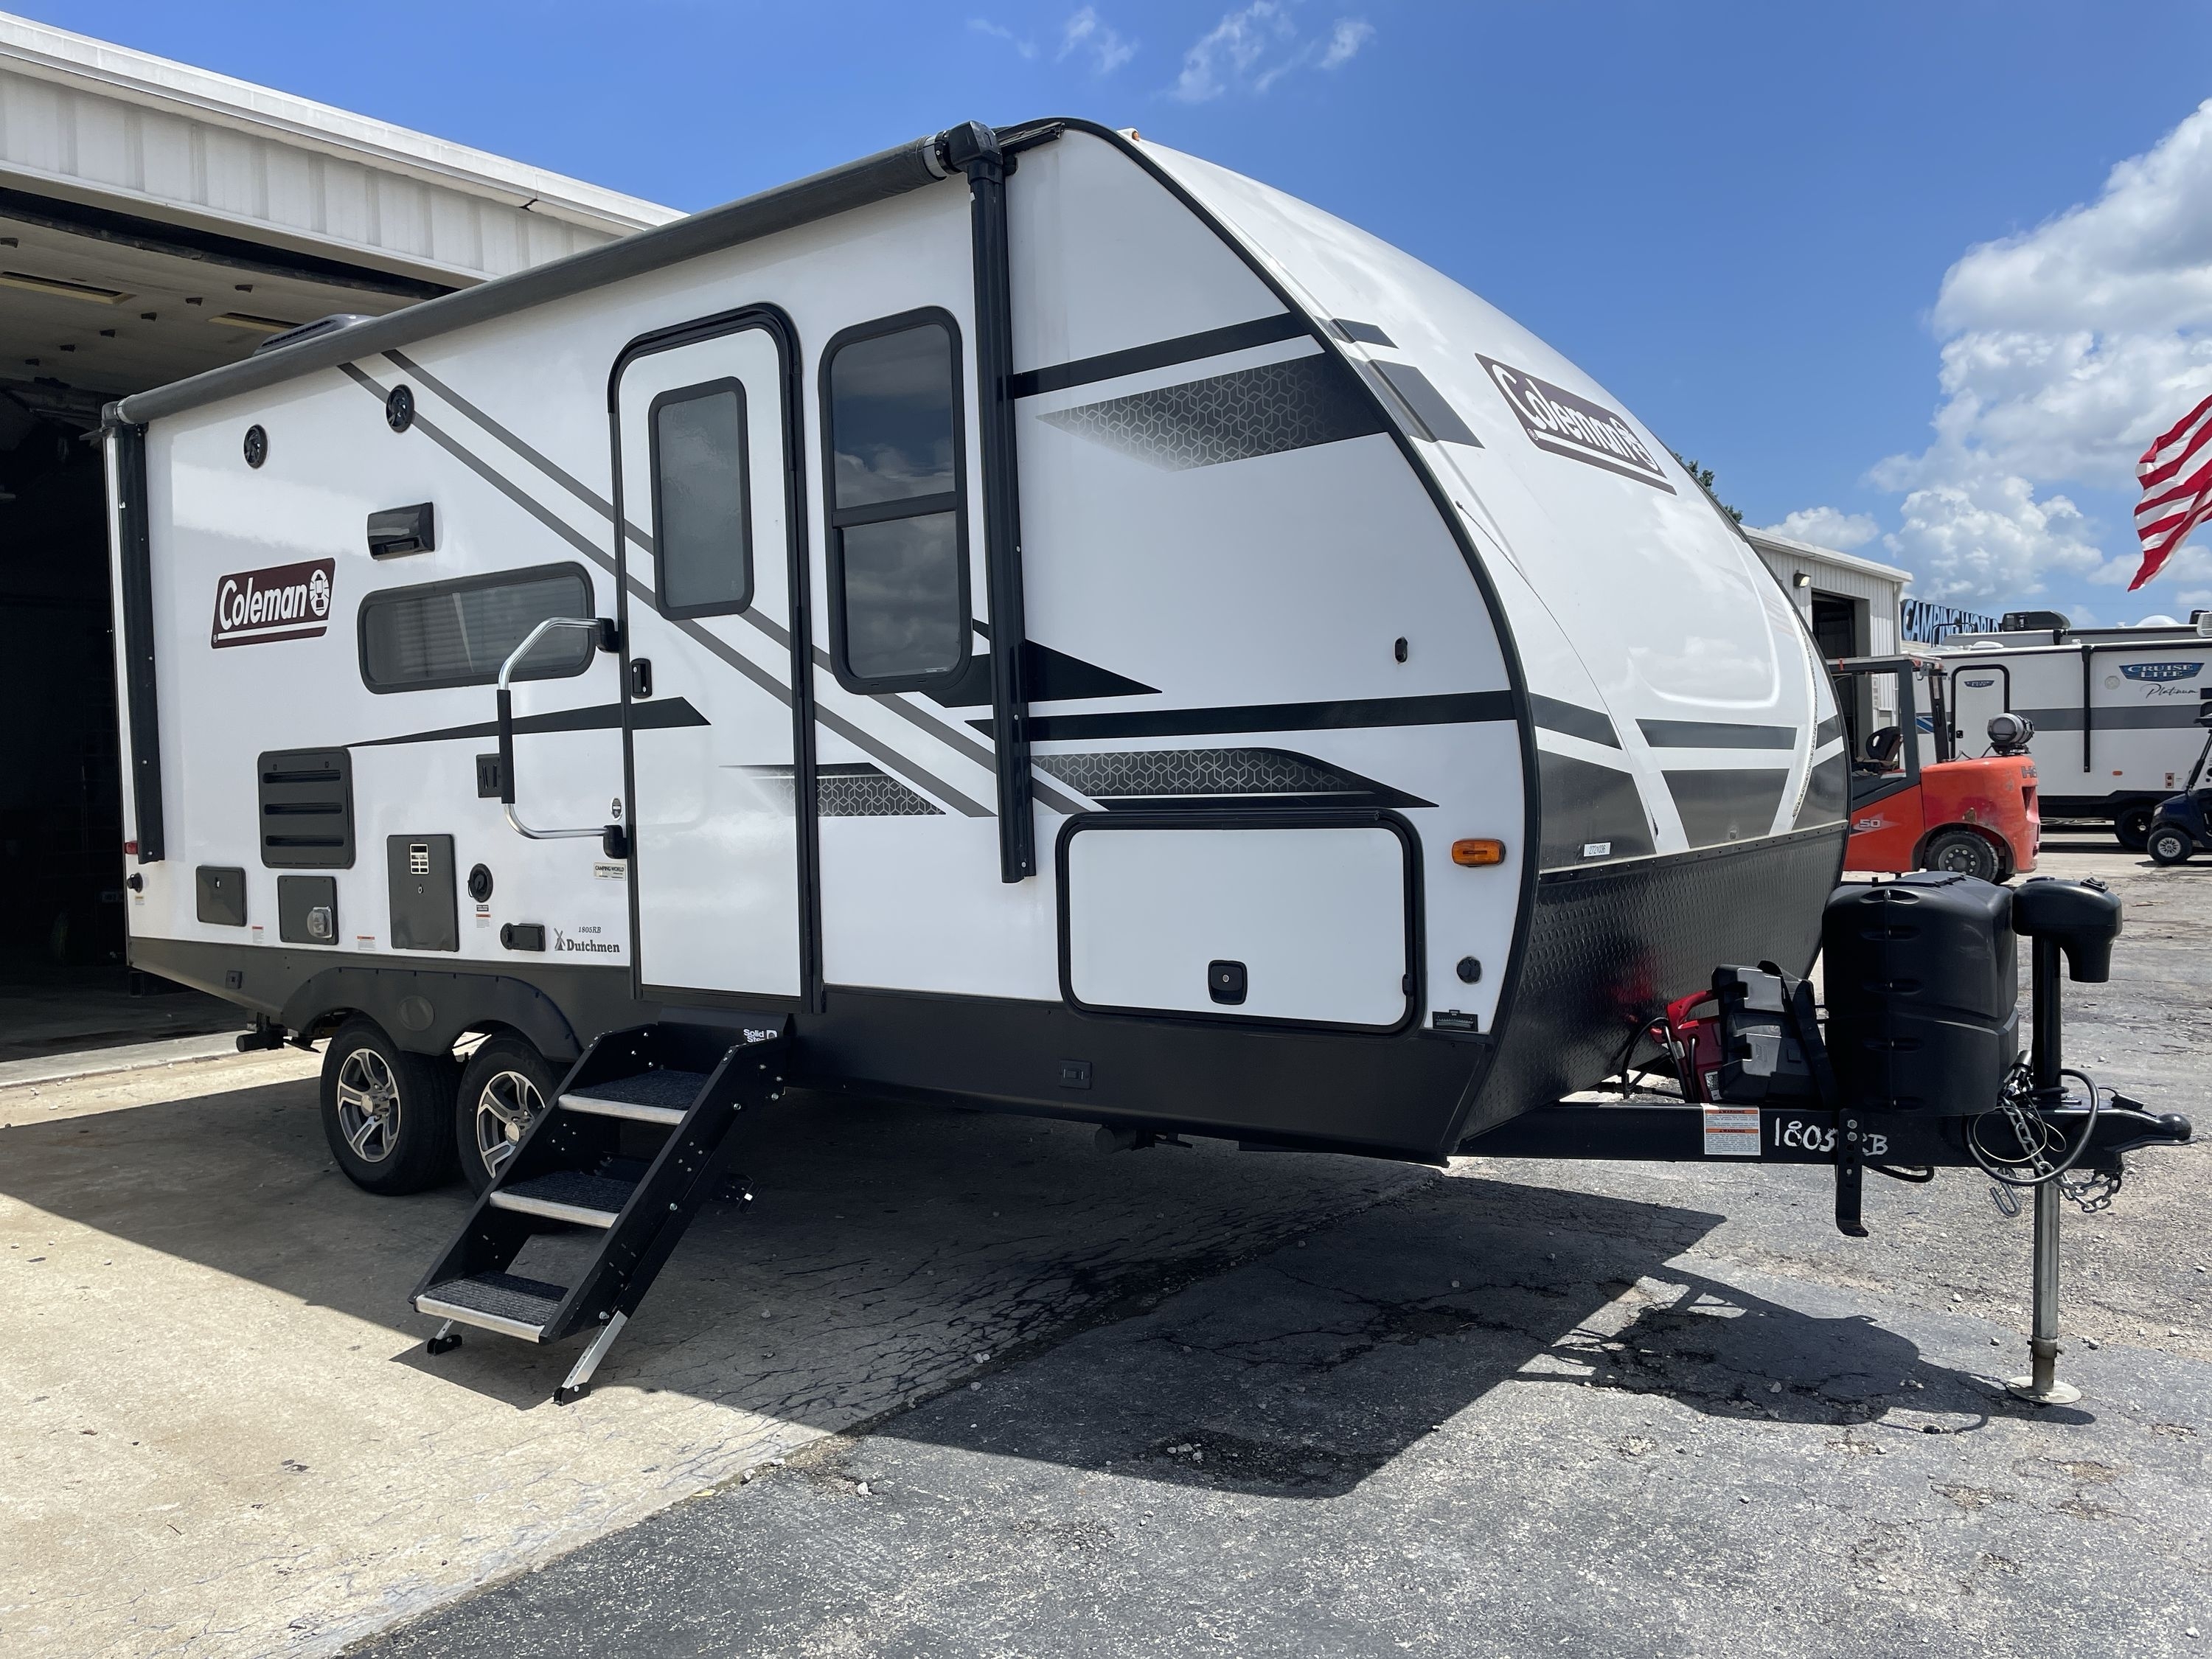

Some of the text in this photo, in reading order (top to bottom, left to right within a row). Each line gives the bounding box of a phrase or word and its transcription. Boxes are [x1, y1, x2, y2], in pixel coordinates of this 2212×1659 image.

[1492, 364, 1638, 462] Coleman
[220, 577, 307, 630] Coleman
[2127, 664, 2194, 672] CRUISE
[2140, 683, 2199, 699] Platinum
[1859, 818, 1881, 828] 50
[566, 939, 620, 953] Dutchmen
[743, 1029, 765, 1038] Solid
[746, 1035, 765, 1043] Ste
